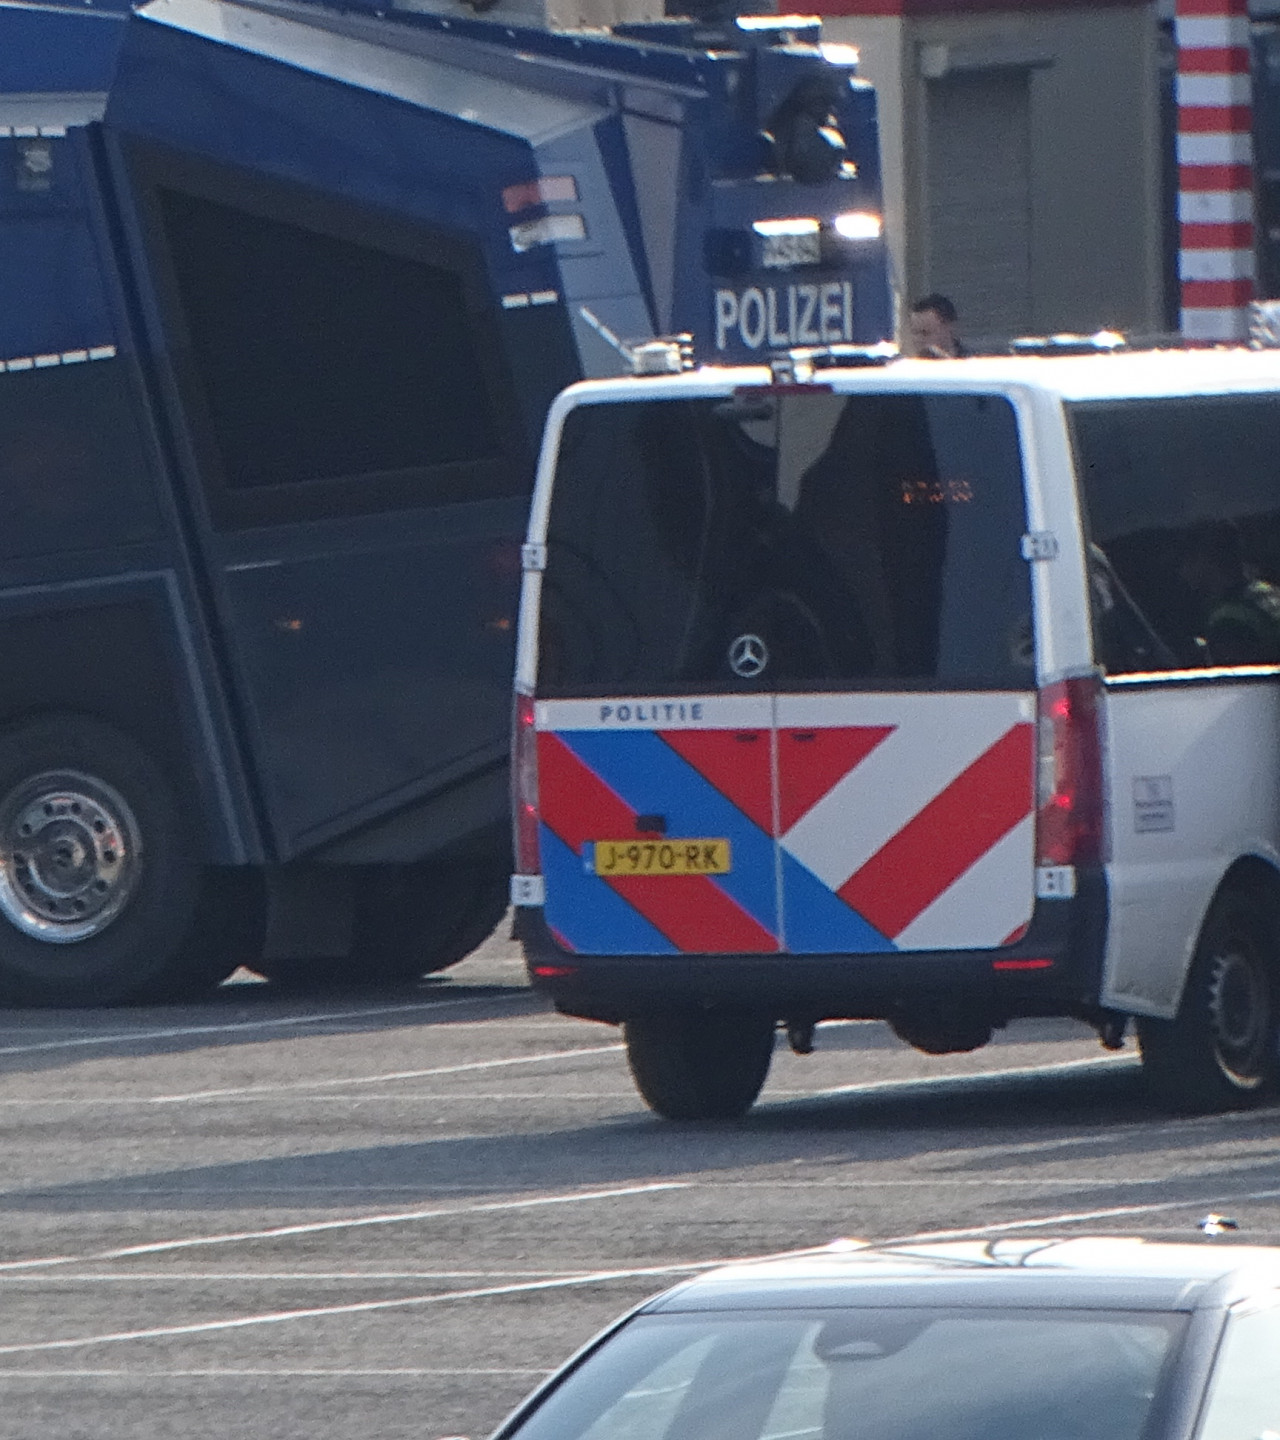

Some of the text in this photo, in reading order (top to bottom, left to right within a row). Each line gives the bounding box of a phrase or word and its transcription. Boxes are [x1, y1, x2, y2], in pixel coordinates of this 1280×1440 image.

[714, 281, 853, 350] POLIZEI
[600, 703, 704, 723] POLITIE
[605, 843, 720, 871] J-970-RK
